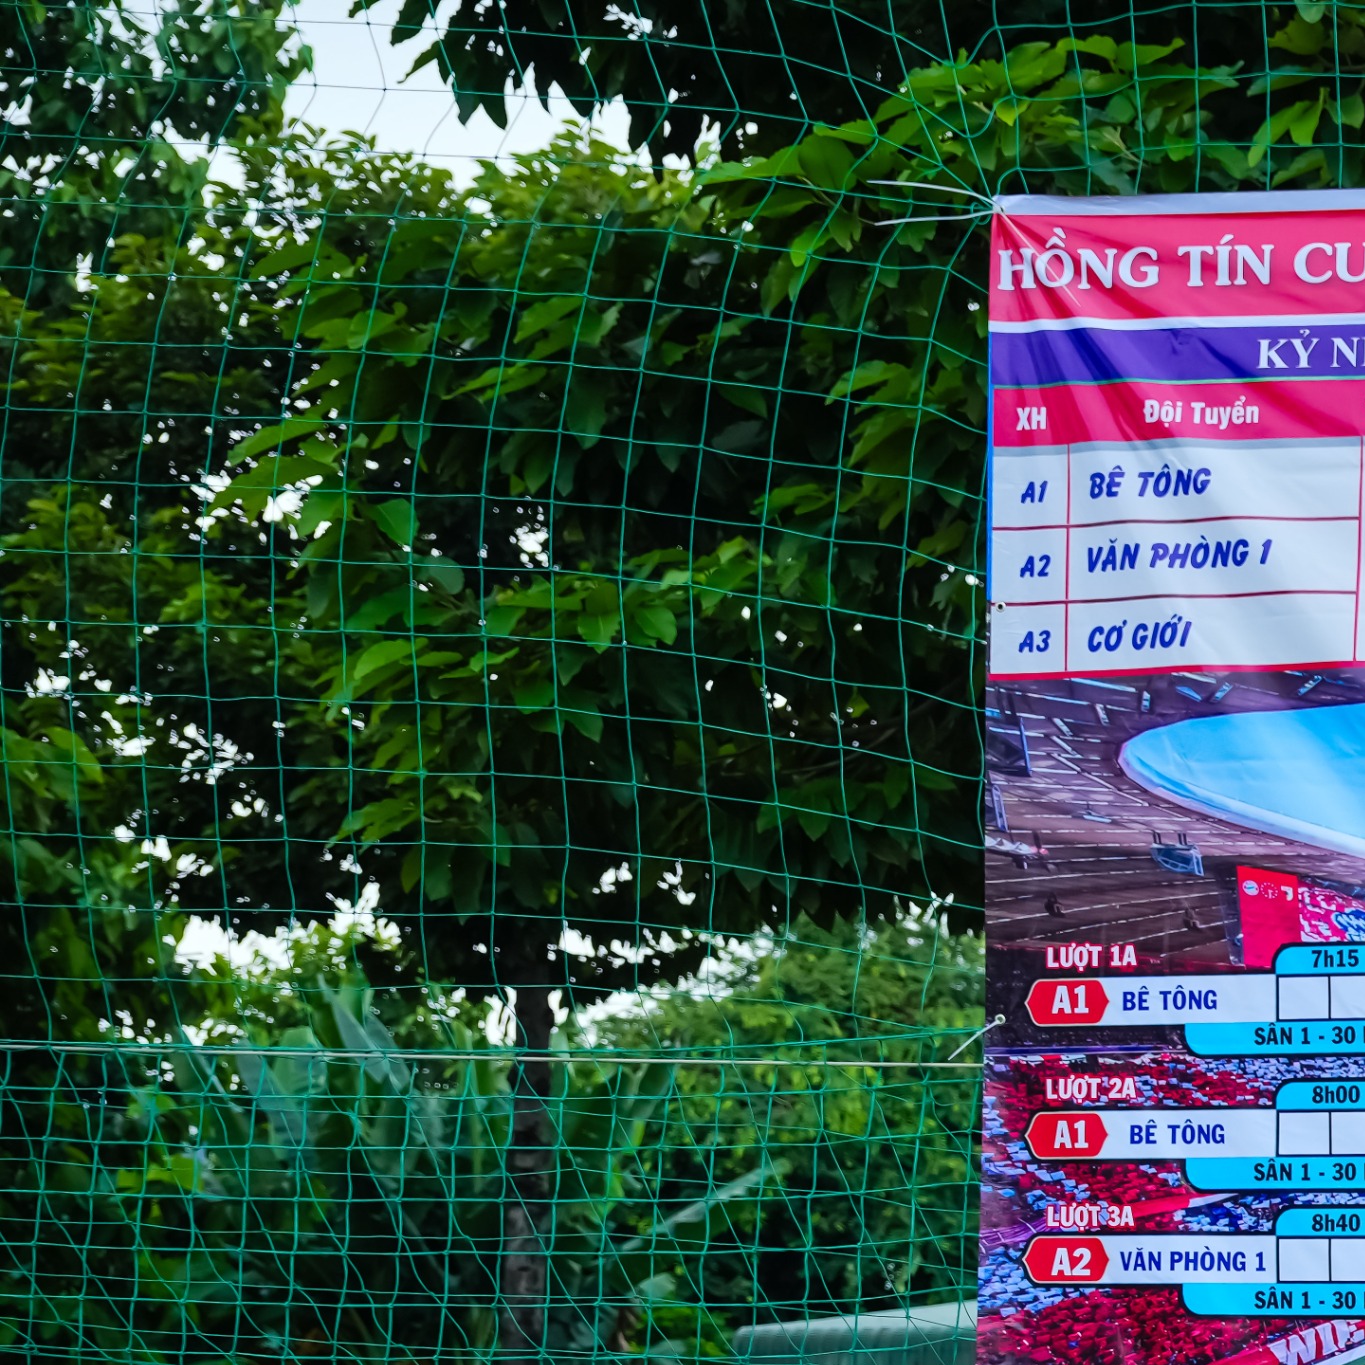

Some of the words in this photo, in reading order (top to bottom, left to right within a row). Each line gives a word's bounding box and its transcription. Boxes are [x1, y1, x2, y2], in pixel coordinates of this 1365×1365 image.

[997, 227, 1160, 291] HỒNG
[1177, 234, 1274, 288] TÍN
[1257, 328, 1320, 370] KỶ
[1016, 407, 1047, 431] XH
[1143, 398, 1183, 426] Đội
[1191, 394, 1260, 428] Tuyển
[1020, 480, 1048, 504] A1
[1089, 465, 1125, 499] BÊ
[1137, 464, 1212, 498] TÔNG
[1019, 554, 1052, 578] A2
[1086, 538, 1139, 574] VĂN
[1149, 534, 1251, 570] PHÒNG
[1259, 538, 1272, 565] 1
[1046, 943, 1103, 972] LƯỢT
[1109, 944, 1137, 967] 1A
[1312, 950, 1359, 968] 7h15
[1051, 985, 1089, 1015] A1
[1122, 984, 1153, 1012] BÊ
[1158, 984, 1219, 1011] TÔNG
